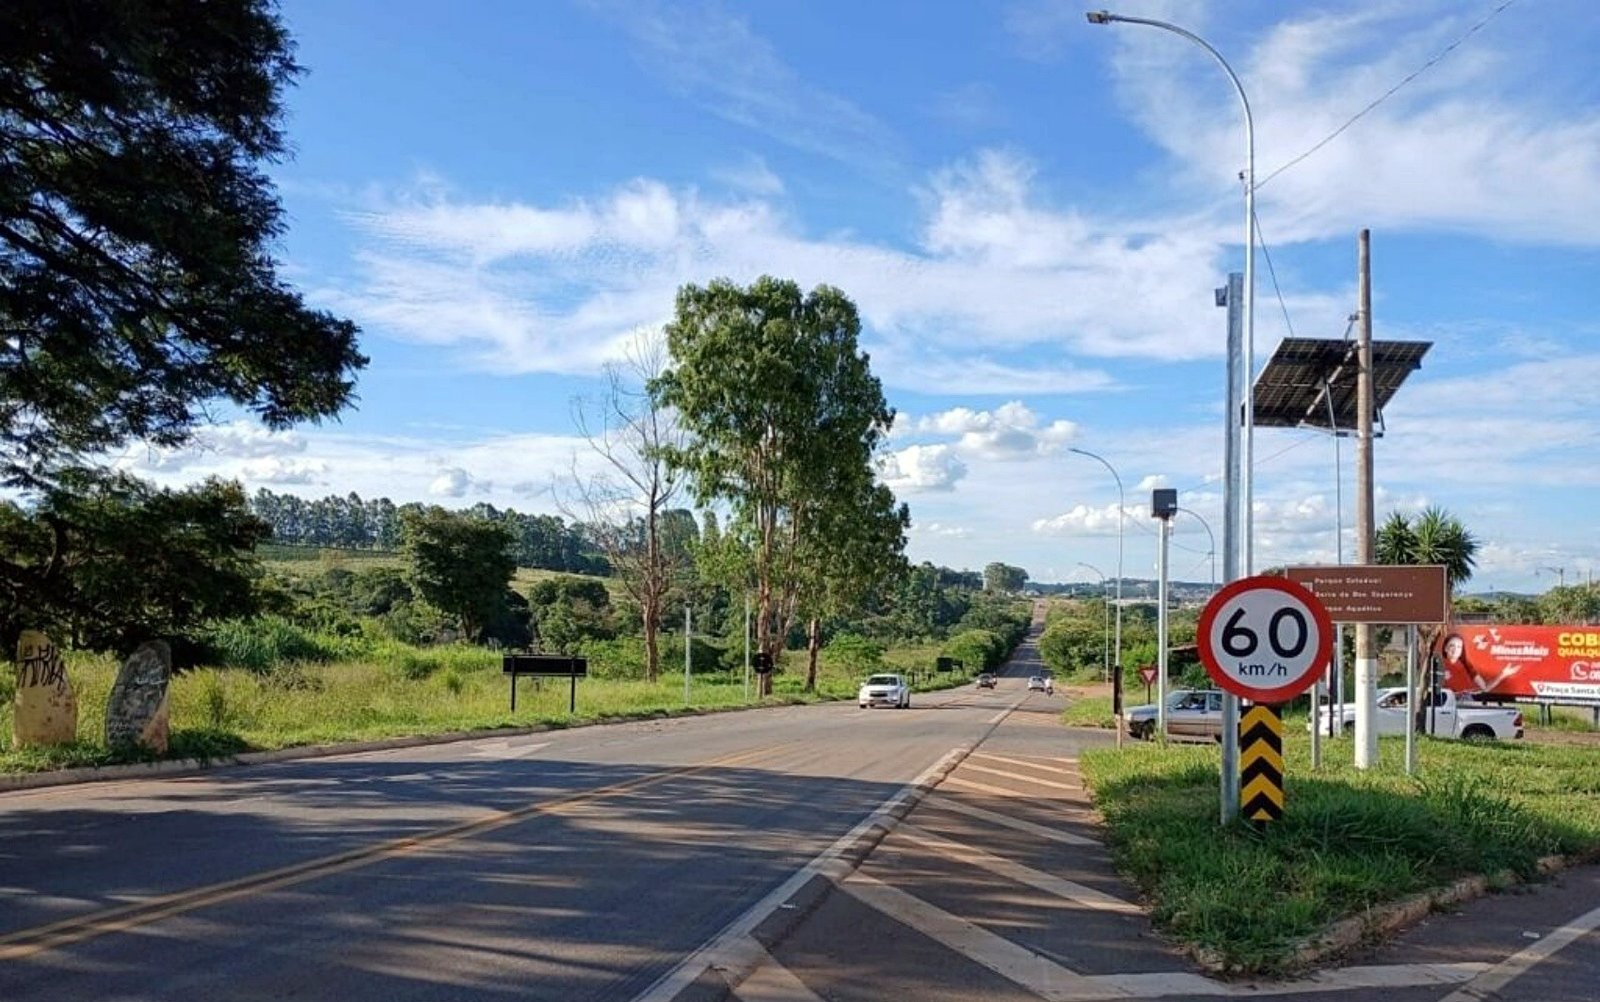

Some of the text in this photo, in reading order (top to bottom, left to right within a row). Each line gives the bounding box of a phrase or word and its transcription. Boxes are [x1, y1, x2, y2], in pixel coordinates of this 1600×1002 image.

[1221, 607, 1308, 659] 60
[1558, 632, 1600, 647] COB
[1239, 662, 1287, 676] km/h
